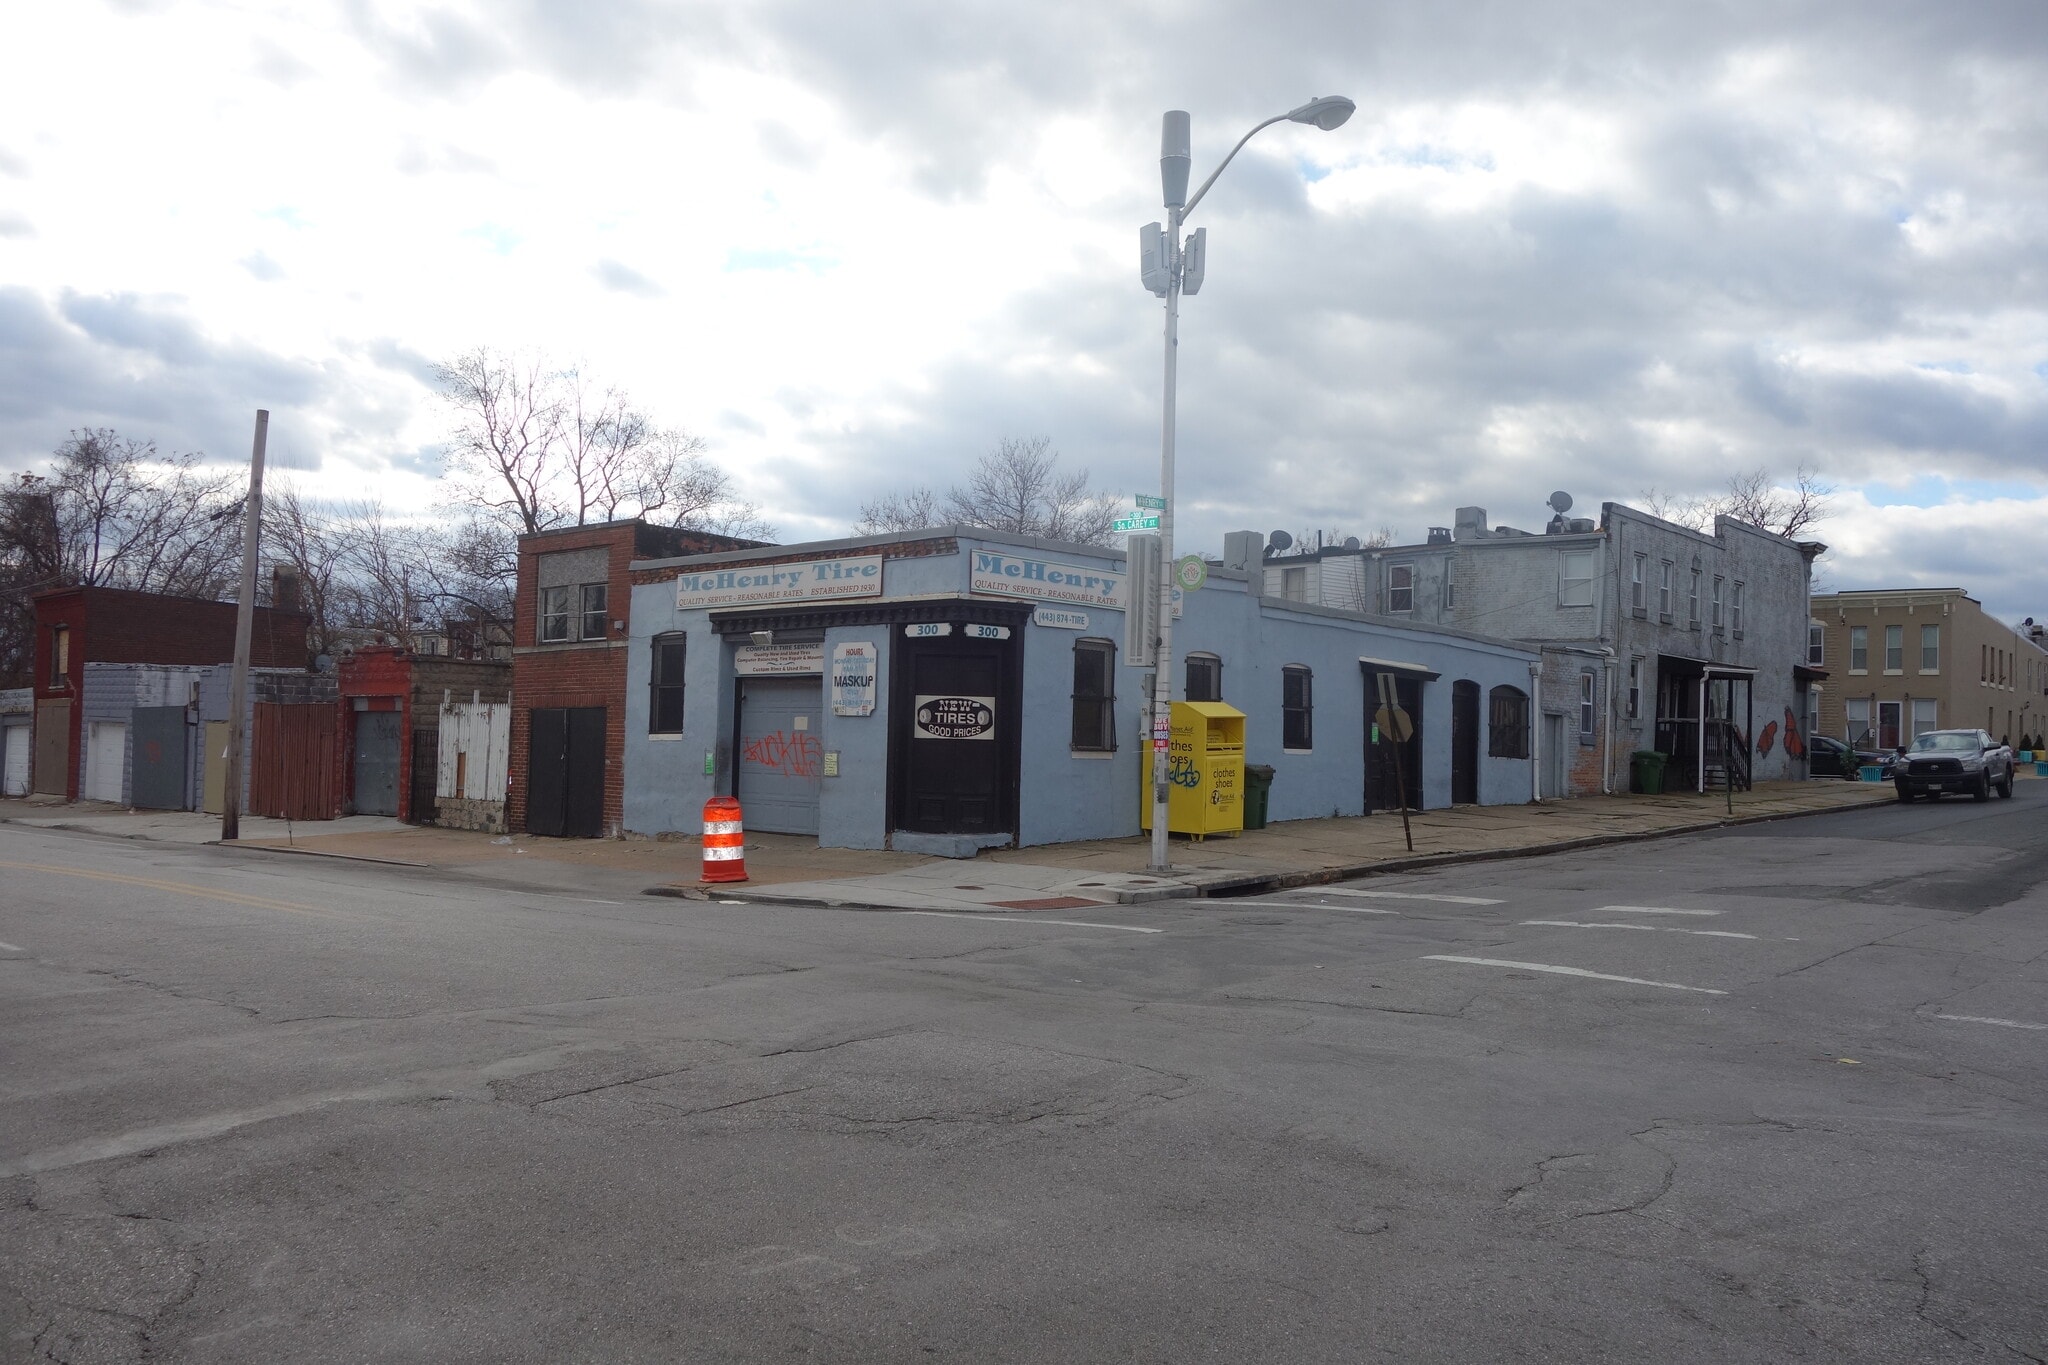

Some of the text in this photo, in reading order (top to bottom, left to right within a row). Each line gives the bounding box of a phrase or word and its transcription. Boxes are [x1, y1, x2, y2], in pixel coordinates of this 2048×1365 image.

[1127, 519, 1148, 529] CAREY
[679, 562, 878, 592] McHenry Tire
[975, 553, 1118, 596] McHenry
[678, 597, 706, 607] QUALITY
[707, 595, 733, 604] SERVICE
[737, 591, 781, 602] REASONABLE
[783, 589, 804, 597] RATES
[811, 584, 859, 596] ESTABLISHED
[860, 583, 876, 592] 1930
[974, 579, 1010, 592] QUALITY
[1012, 584, 1043, 596] SERVICE
[1048, 589, 1095, 603] REASONABLE
[1096, 596, 1118, 606] RATES
[1038, 611, 1056, 624] (443)
[917, 625, 939, 635] 300
[977, 626, 999, 638] 300
[779, 643, 793, 651] TIRE
[846, 648, 864, 656] HOURS
[938, 699, 972, 711] NEW
[934, 712, 976, 724] TIRES
[928, 724, 982, 737] GOOD PRICES
[1170, 739, 1193, 751] thes
[1170, 755, 1189, 764] oes
[1213, 767, 1236, 779] clothes
[1215, 778, 1233, 789] shoes
